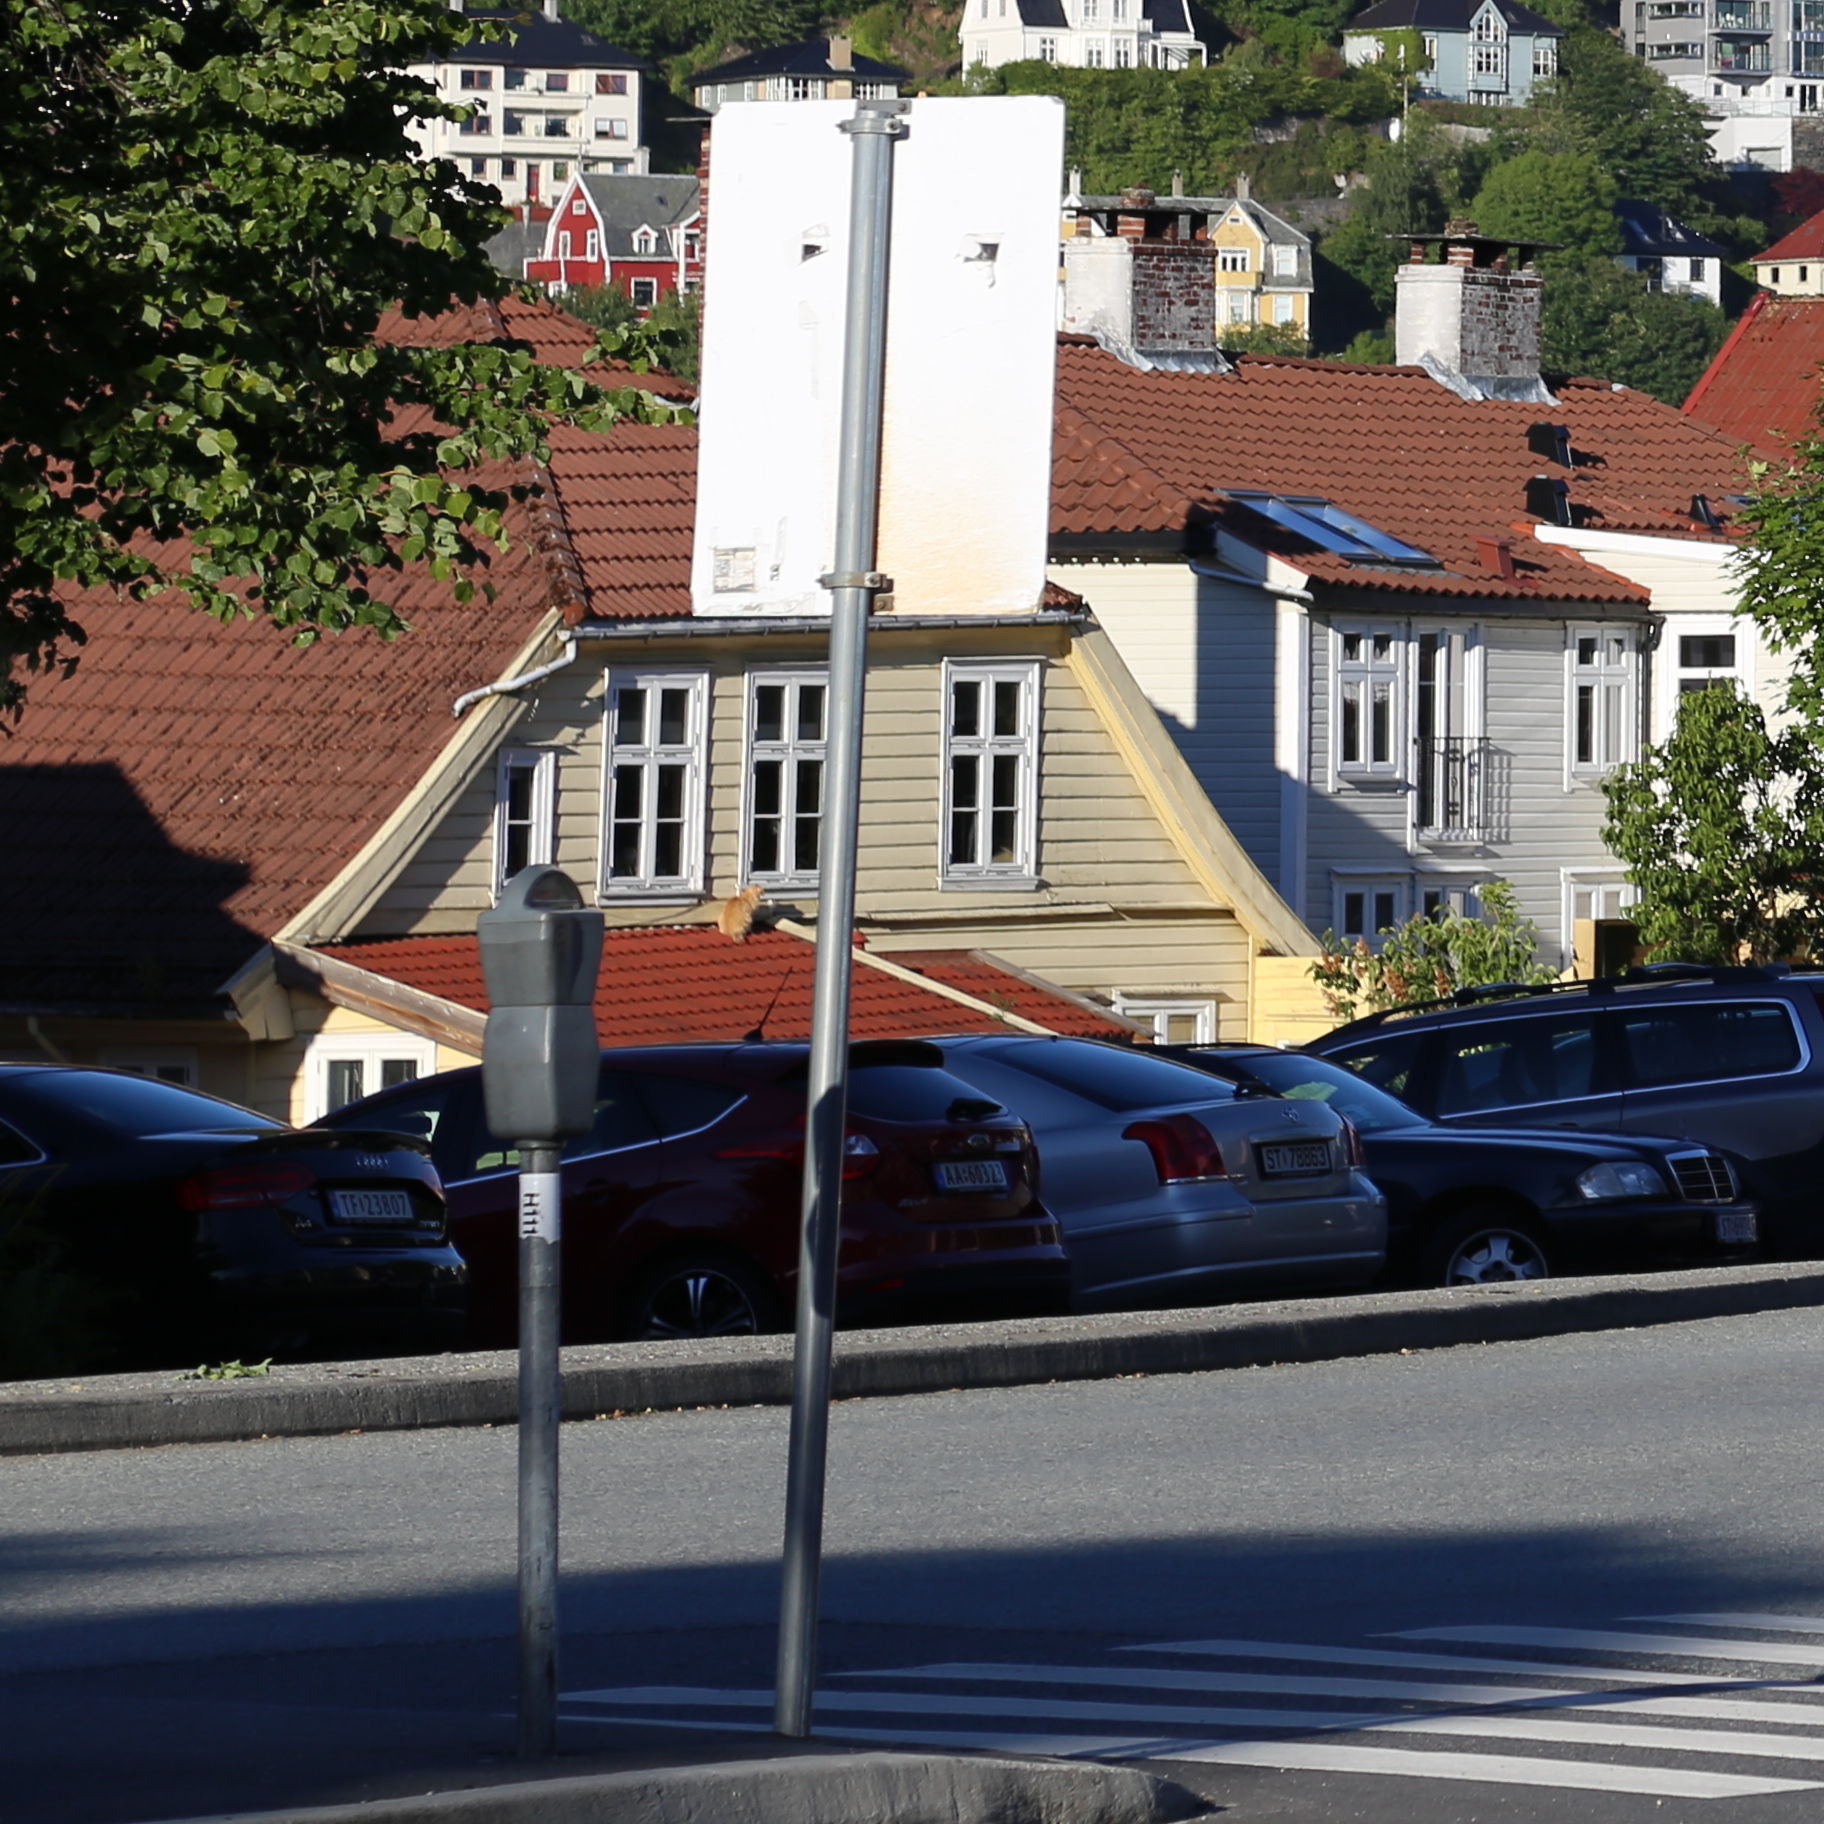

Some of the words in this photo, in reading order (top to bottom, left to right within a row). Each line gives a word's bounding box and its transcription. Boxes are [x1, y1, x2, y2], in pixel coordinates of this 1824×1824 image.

[1265, 1148, 1281, 1170] ST
[945, 1165, 965, 1185] AA
[340, 1194, 360, 1216] TF
[367, 1194, 407, 1216] 23807
[522, 1193, 541, 1235] H111
